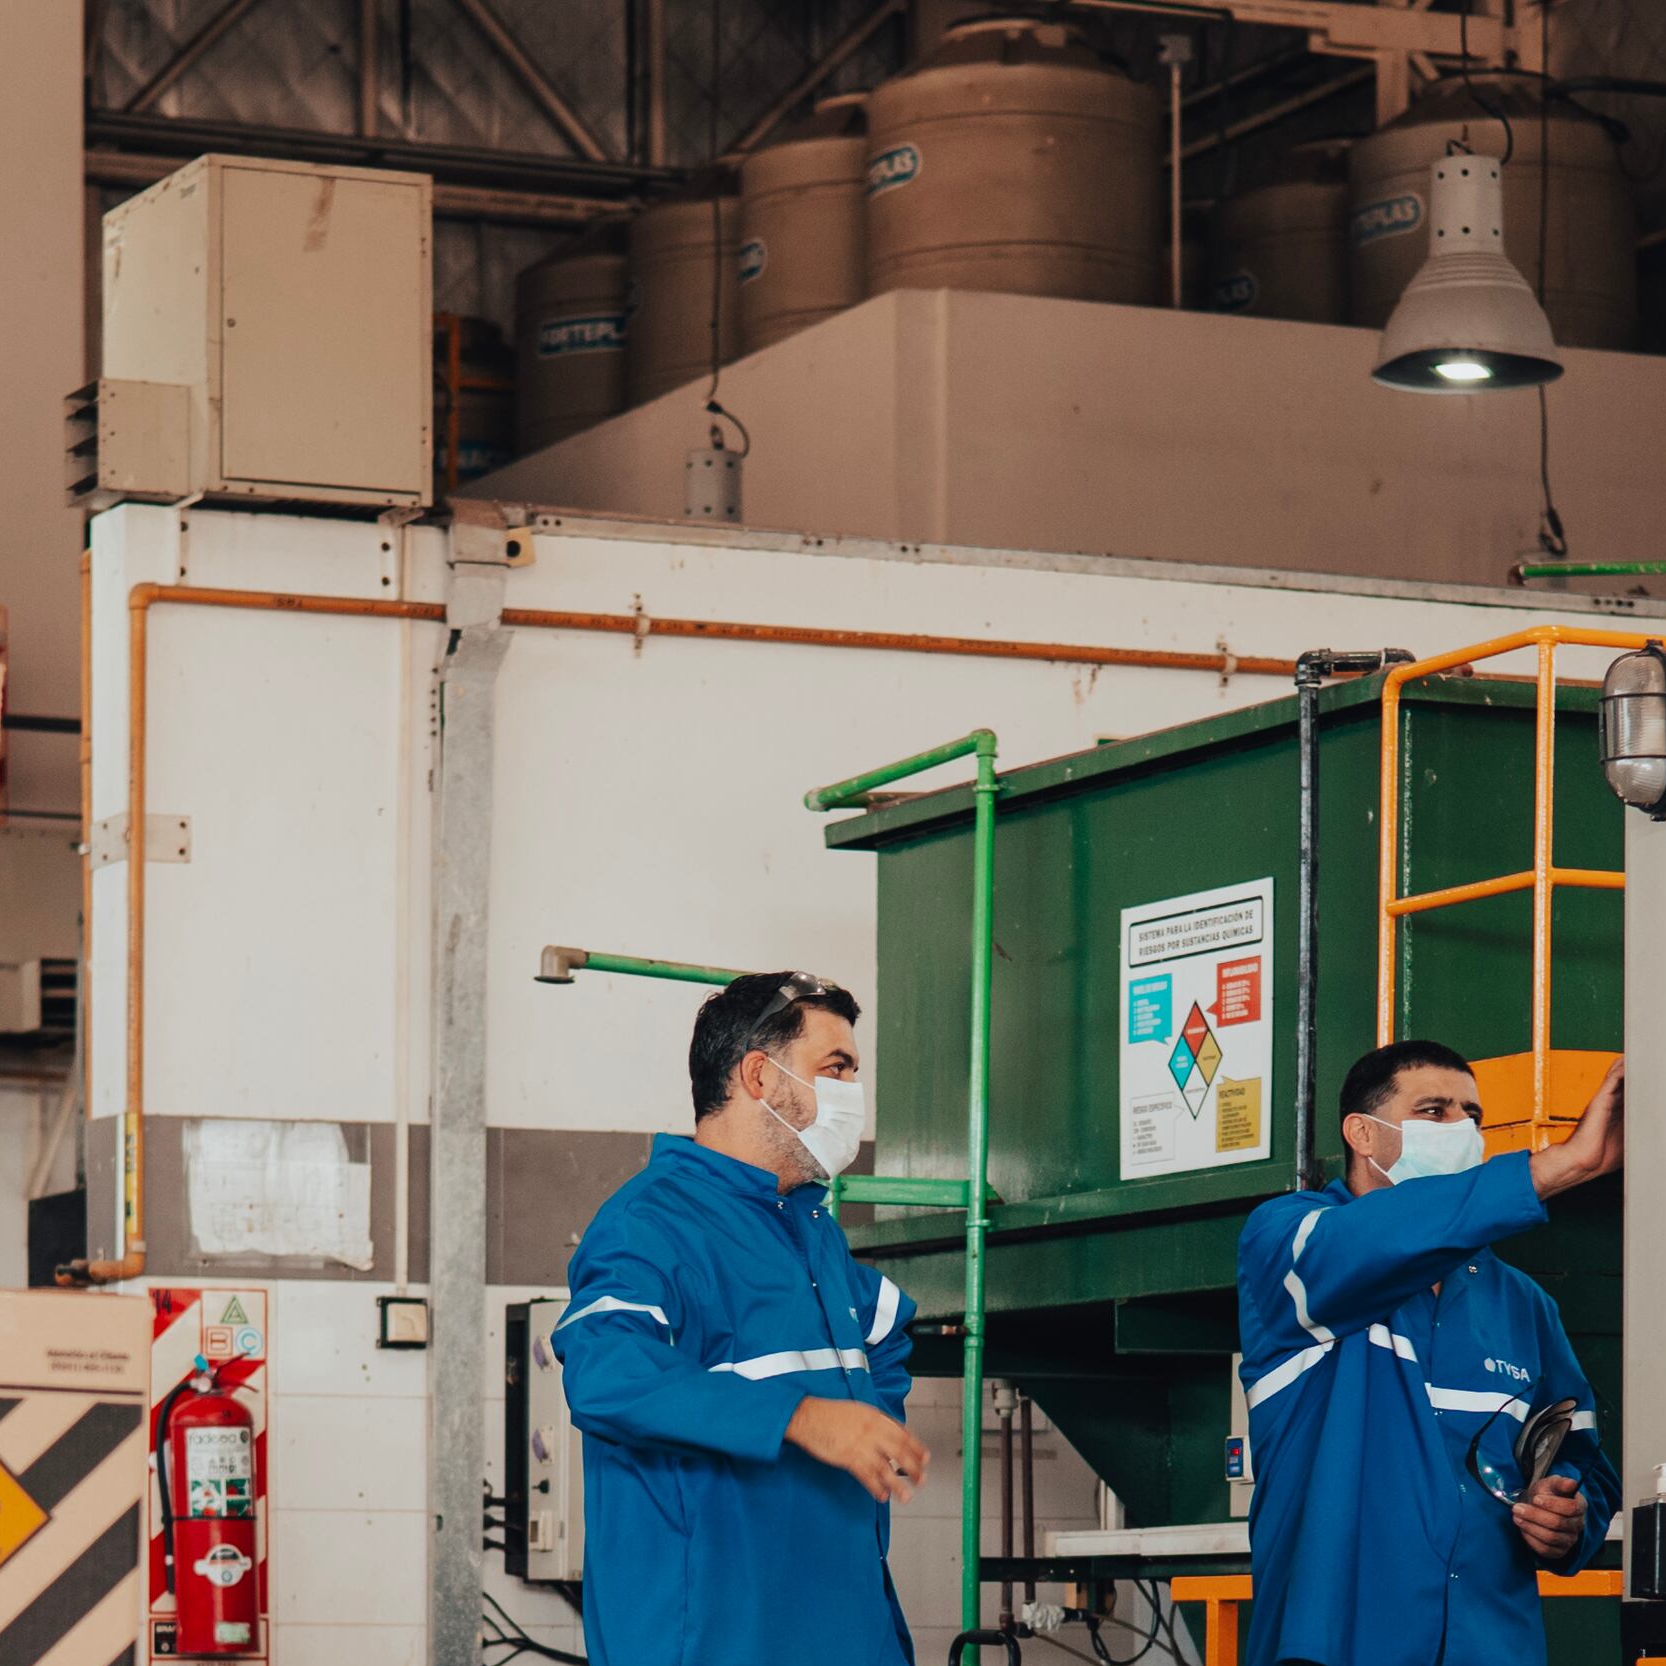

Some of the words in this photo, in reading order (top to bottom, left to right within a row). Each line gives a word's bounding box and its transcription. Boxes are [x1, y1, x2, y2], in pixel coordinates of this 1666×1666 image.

[1139, 929, 1165, 942] SISTEMA
[1166, 925, 1183, 936] PARA
[1183, 922, 1192, 932] LA
[1193, 911, 1243, 930] IDENTIFICACIÓN
[1244, 909, 1254, 920] DE
[1139, 943, 1165, 957] RIESGOS
[1167, 939, 1181, 951] POR
[1182, 931, 1220, 949] SUSTANCIAS
[1495, 1357, 1531, 1383] TYSA
